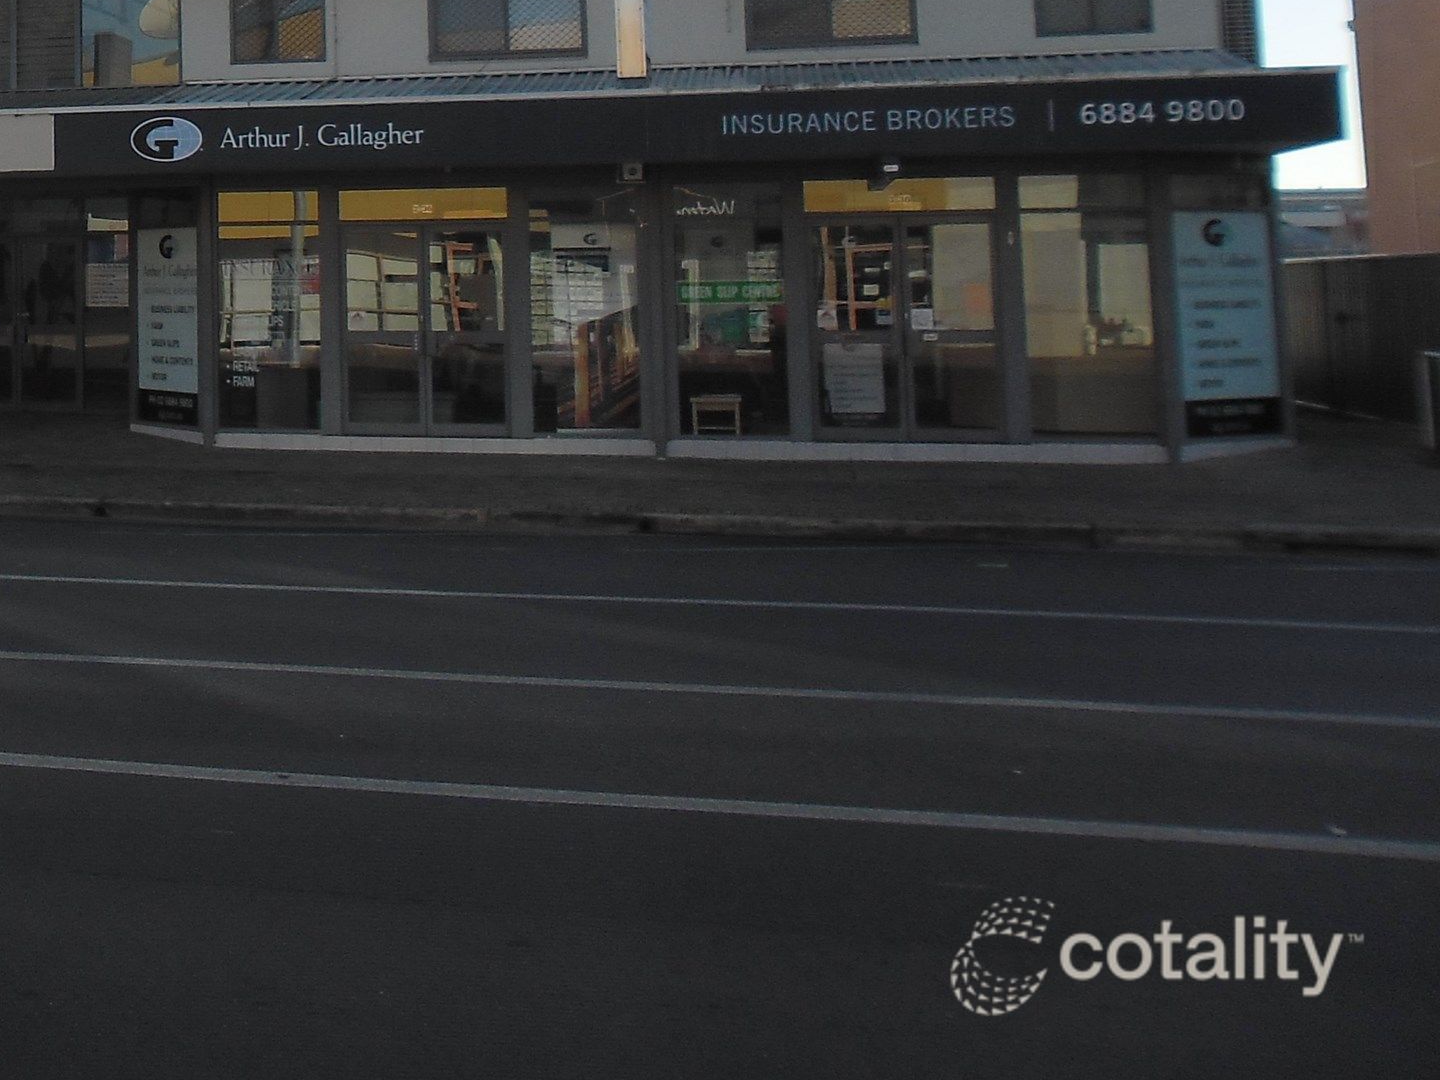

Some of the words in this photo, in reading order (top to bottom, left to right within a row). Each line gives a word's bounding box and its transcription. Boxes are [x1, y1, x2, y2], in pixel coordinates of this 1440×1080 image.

[721, 111, 877, 135] INSURANCE
[887, 106, 1016, 131] BROKERS
[1078, 102, 1156, 125] 6884
[1165, 98, 1246, 122] 9800
[220, 126, 291, 149] Arthur
[294, 125, 309, 151] J.
[317, 123, 425, 150] Gallagher
[232, 360, 259, 372] RETAIL
[232, 376, 255, 387] FARM
